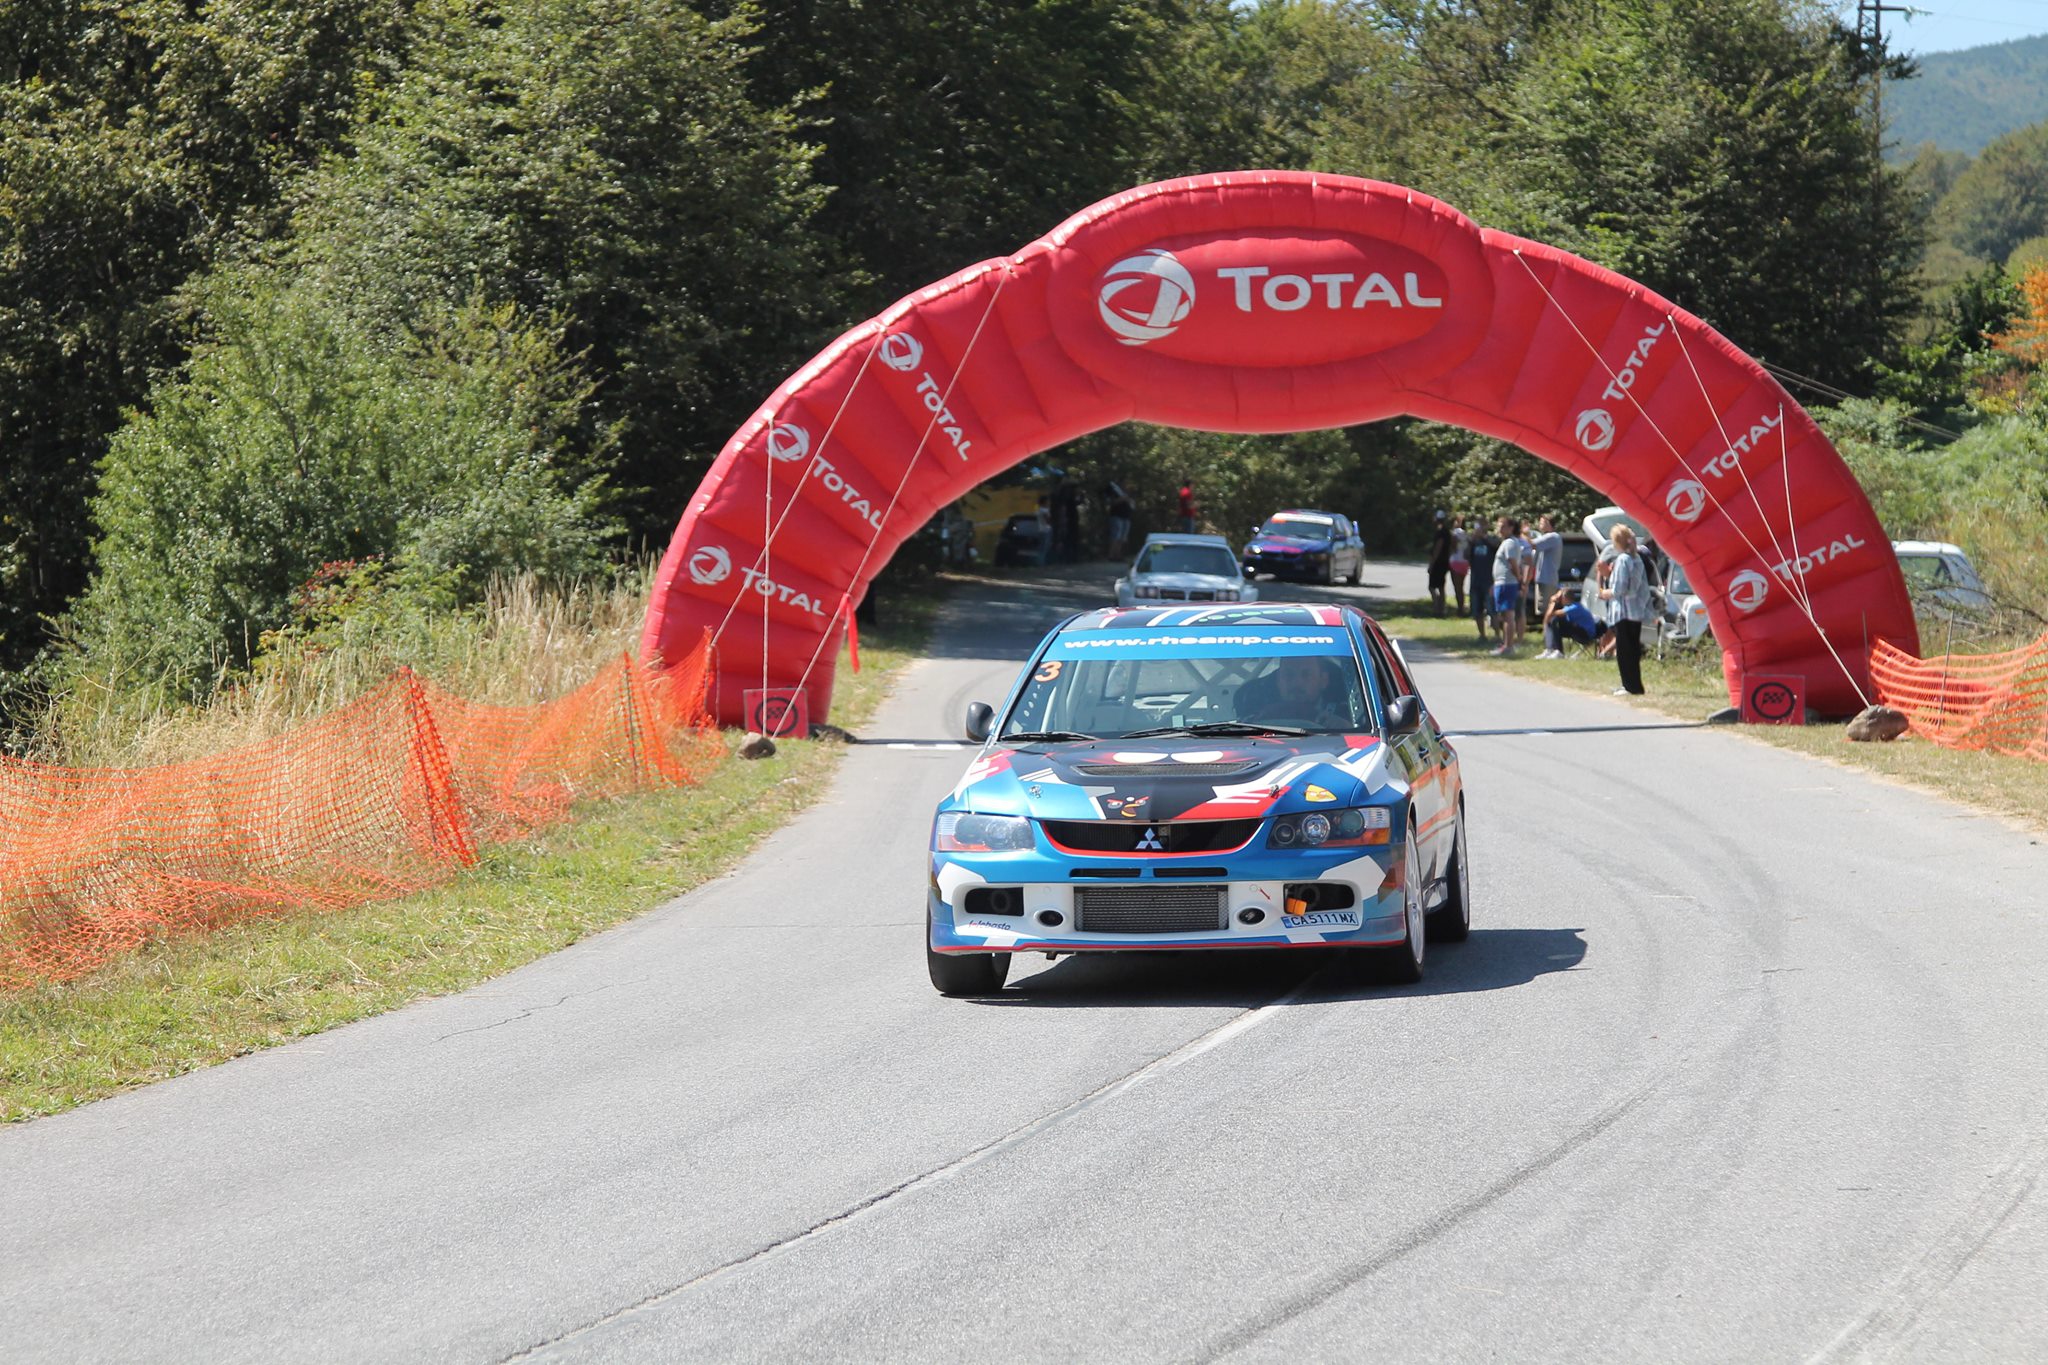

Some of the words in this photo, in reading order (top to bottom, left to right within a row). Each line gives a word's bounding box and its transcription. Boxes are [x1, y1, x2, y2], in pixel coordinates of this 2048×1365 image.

[1217, 266, 1442, 312] TOTAL
[1602, 321, 1665, 401] TOTAL
[916, 373, 971, 461] TOTAL
[1702, 413, 1781, 478] TOTAL
[812, 458, 882, 530] TOTAL
[1773, 534, 1865, 580] TOTAL
[741, 567, 825, 616] TOTAL
[1034, 661, 1063, 682] 3
